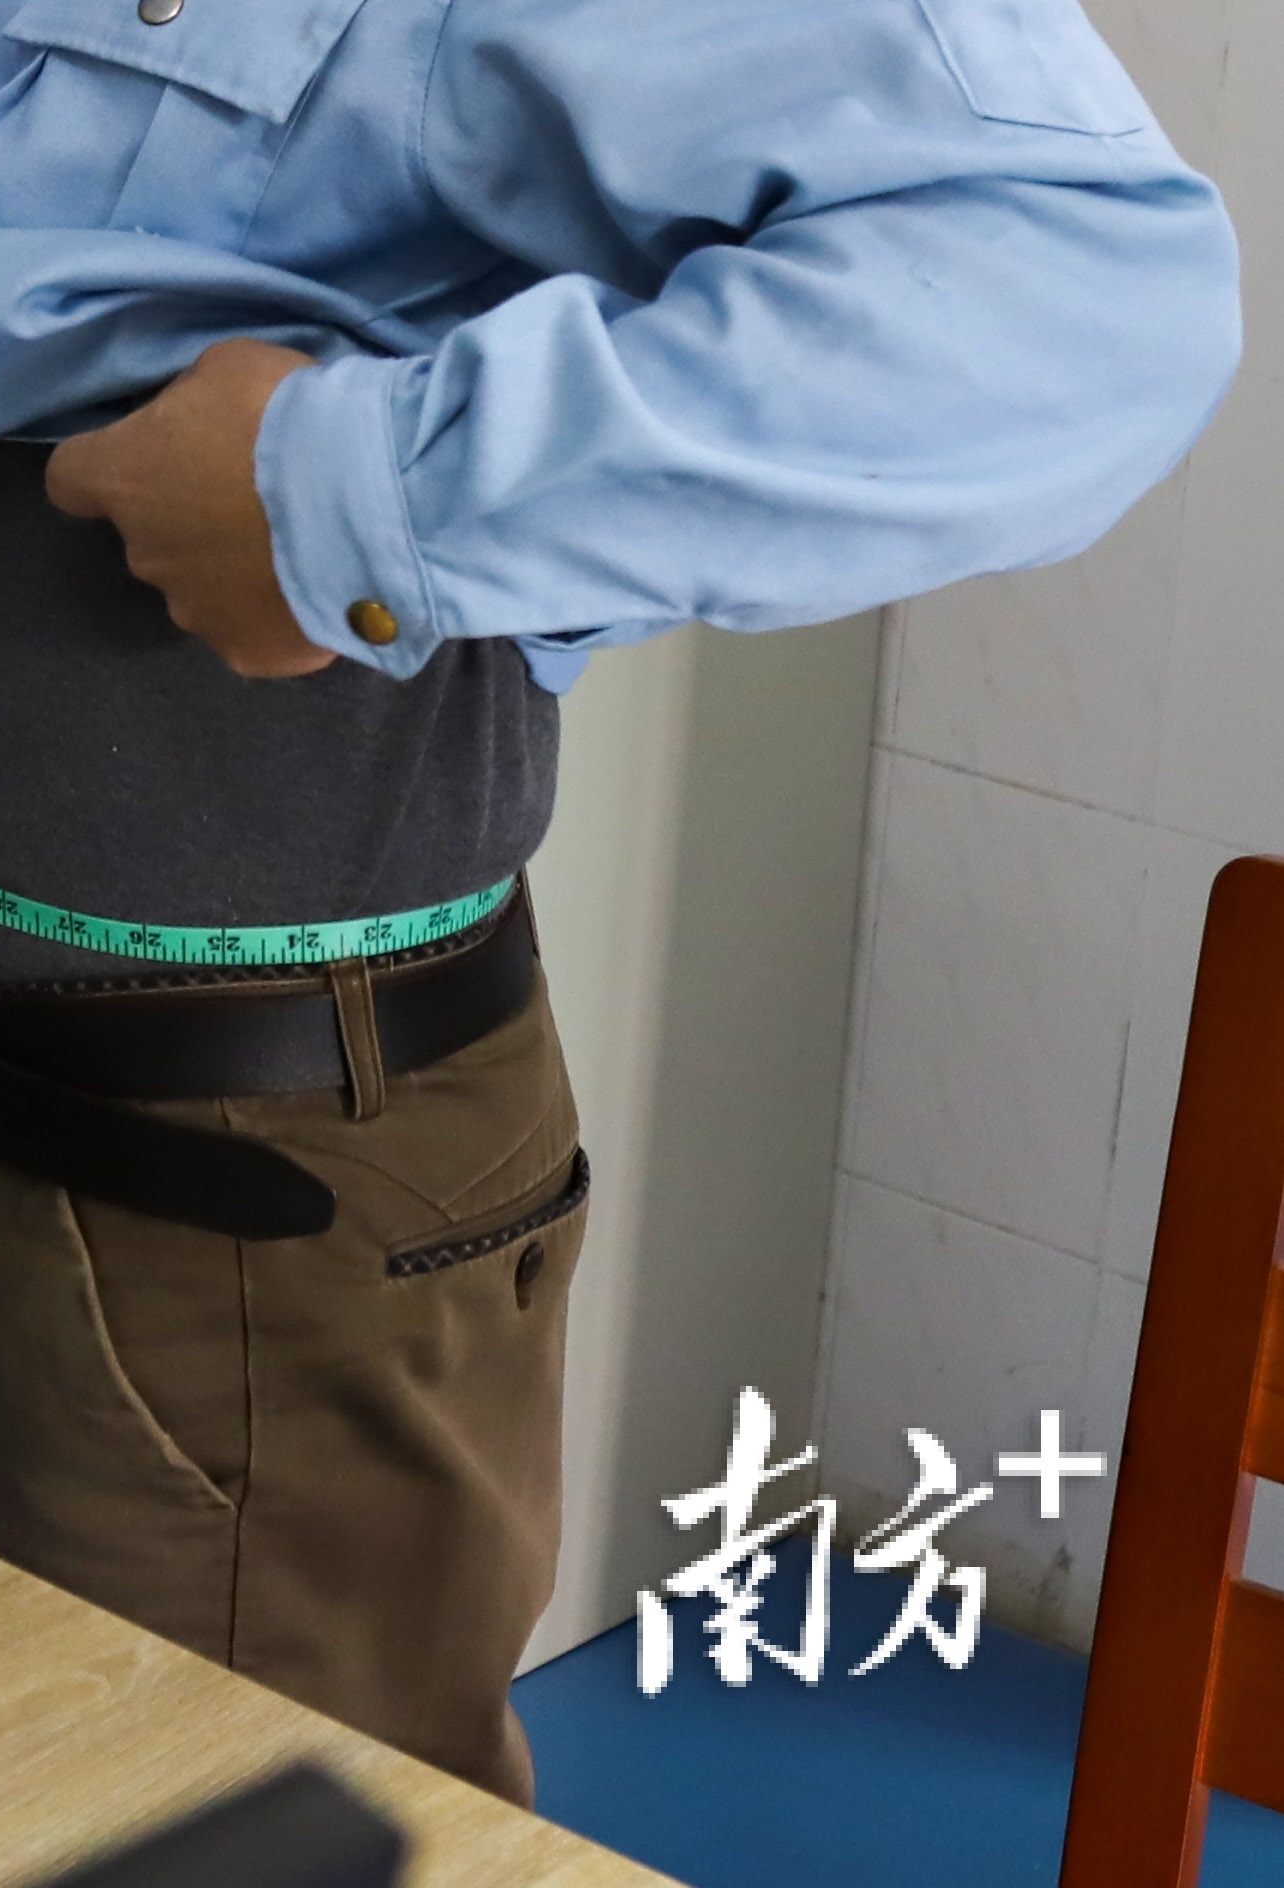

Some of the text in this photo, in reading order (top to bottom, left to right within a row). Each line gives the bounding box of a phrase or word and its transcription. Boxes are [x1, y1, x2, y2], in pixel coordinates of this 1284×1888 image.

[57, 916, 87, 934] 27
[428, 907, 452, 928] 22
[129, 931, 161, 947] 26
[287, 931, 320, 949] 24
[363, 923, 392, 942] 23
[207, 935, 241, 951] 25
